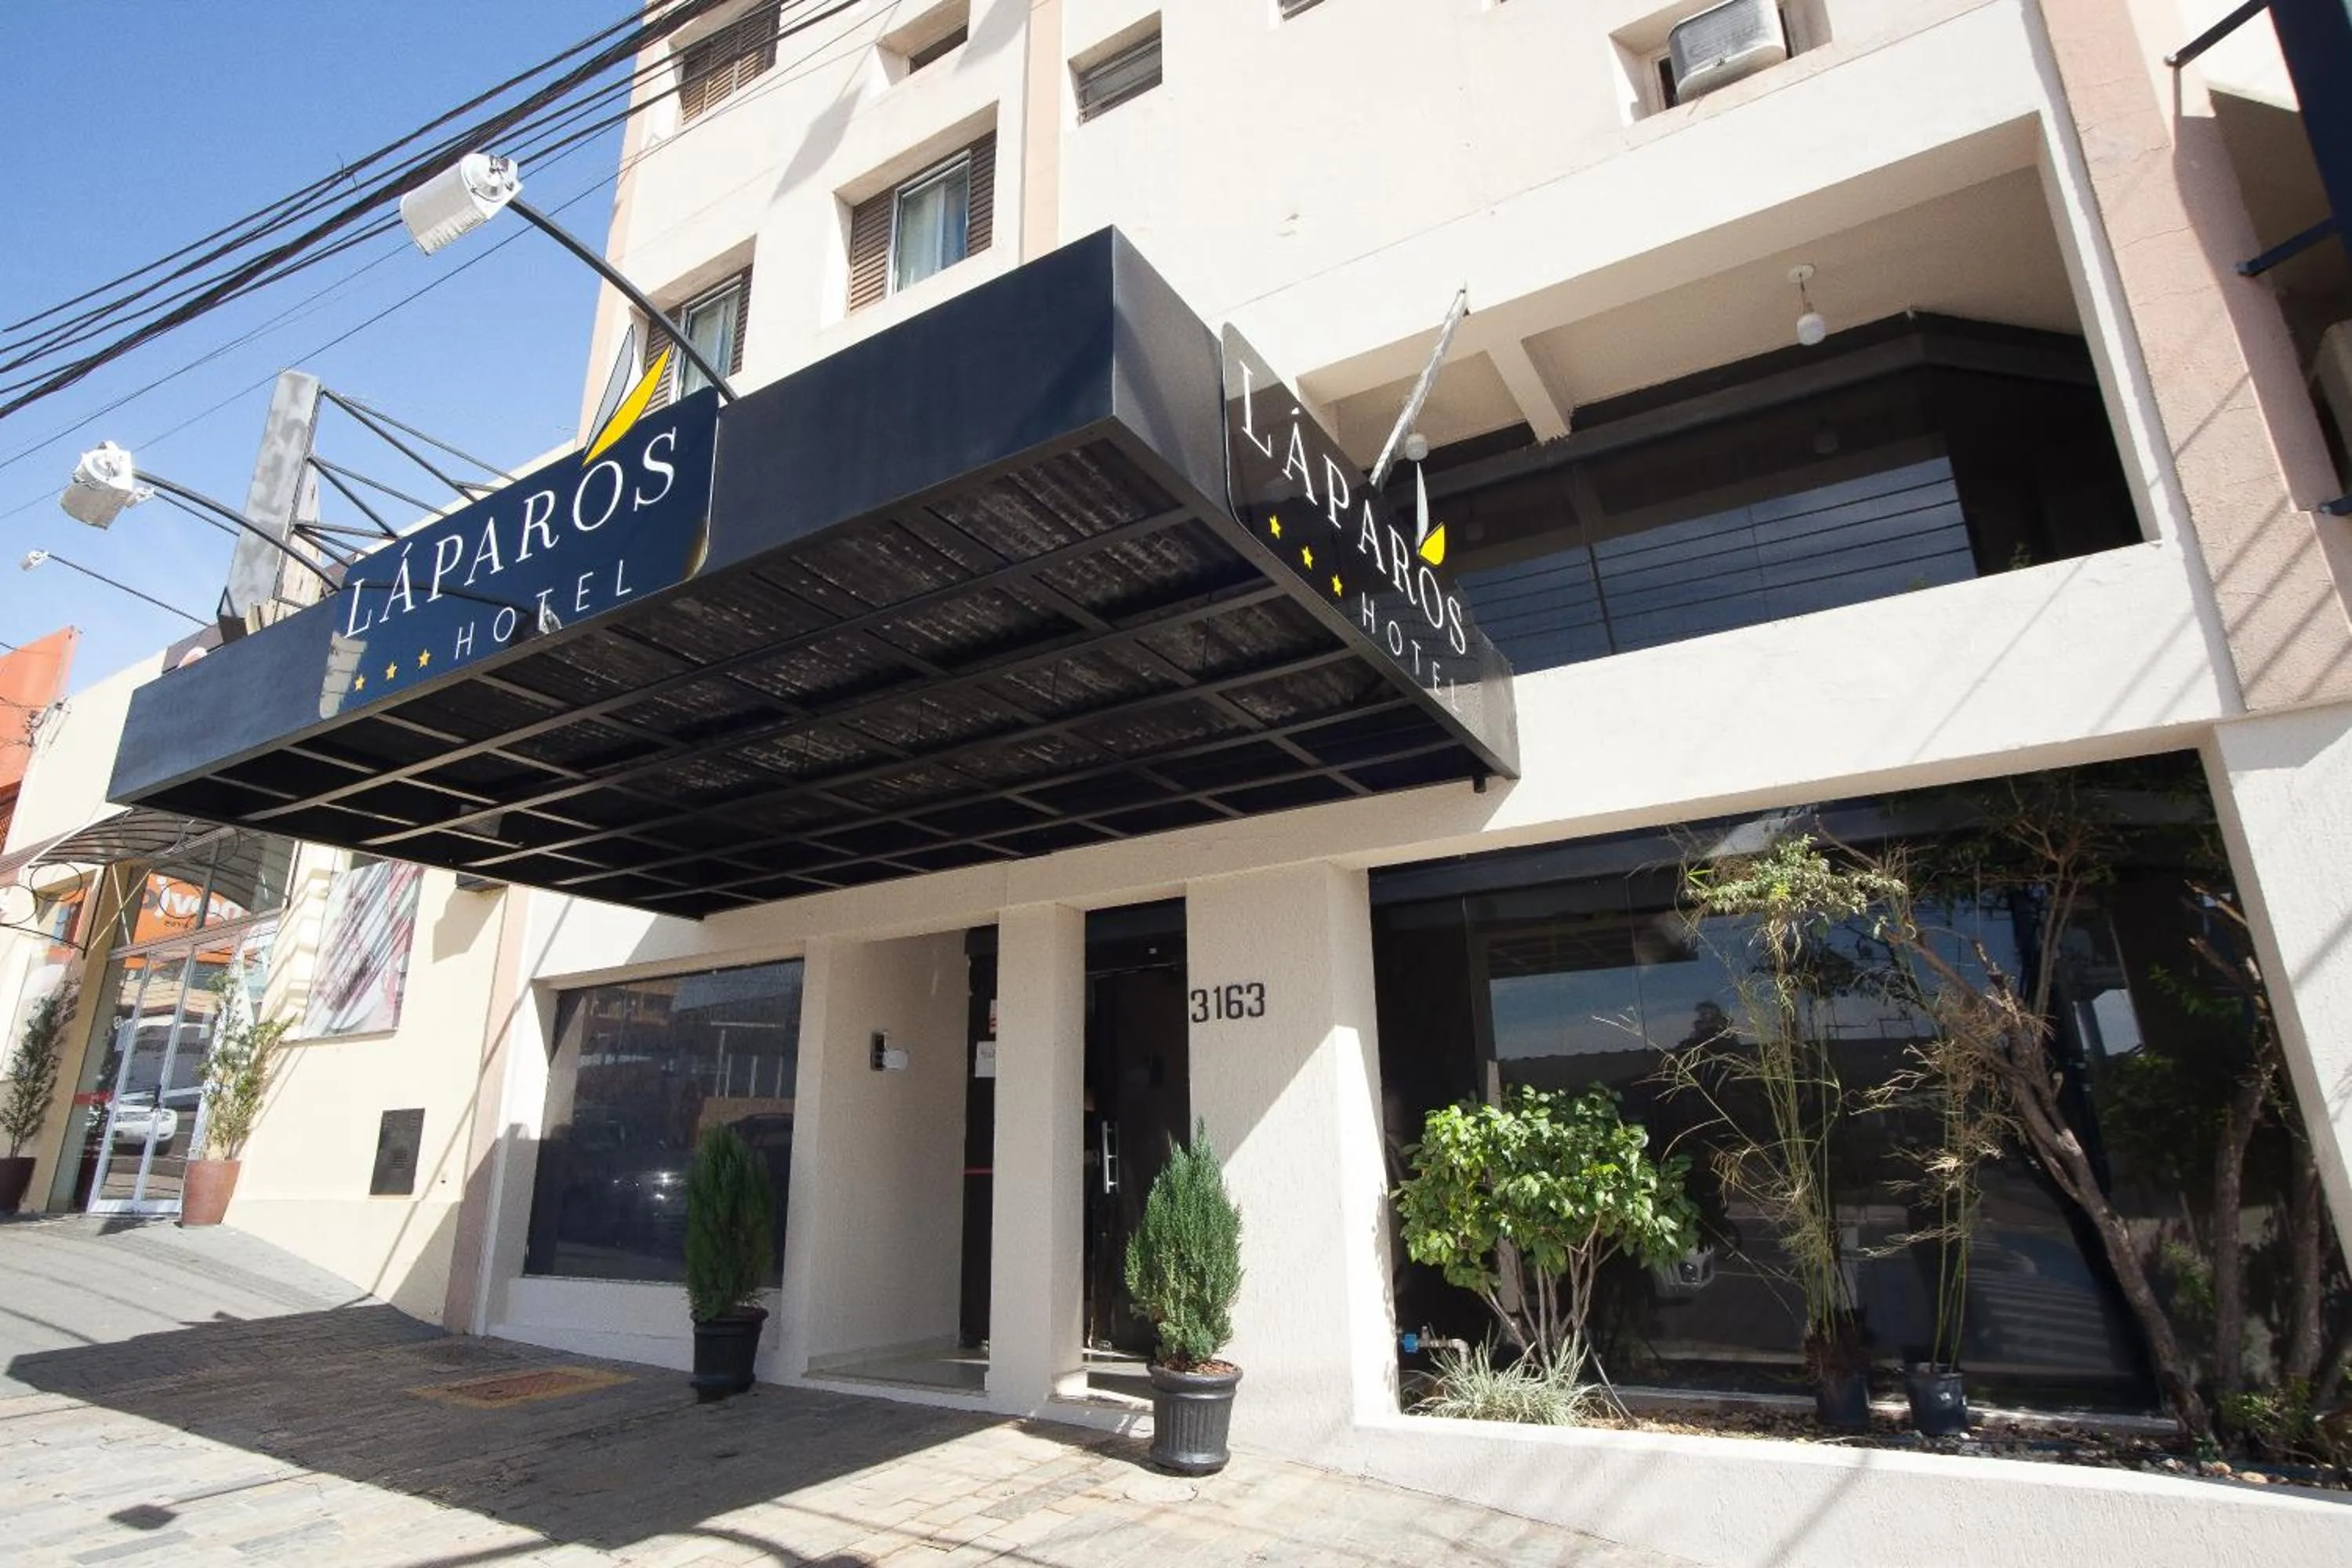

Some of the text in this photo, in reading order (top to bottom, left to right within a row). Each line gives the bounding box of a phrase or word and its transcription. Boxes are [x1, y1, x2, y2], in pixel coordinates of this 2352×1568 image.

[346, 426, 677, 638] LÁPAROS
[1240, 361, 1465, 655] LÁPAROS
[455, 559, 633, 661] HOTEL
[1362, 592, 1461, 714] HOTEL
[1189, 982, 1266, 1023] 3163
